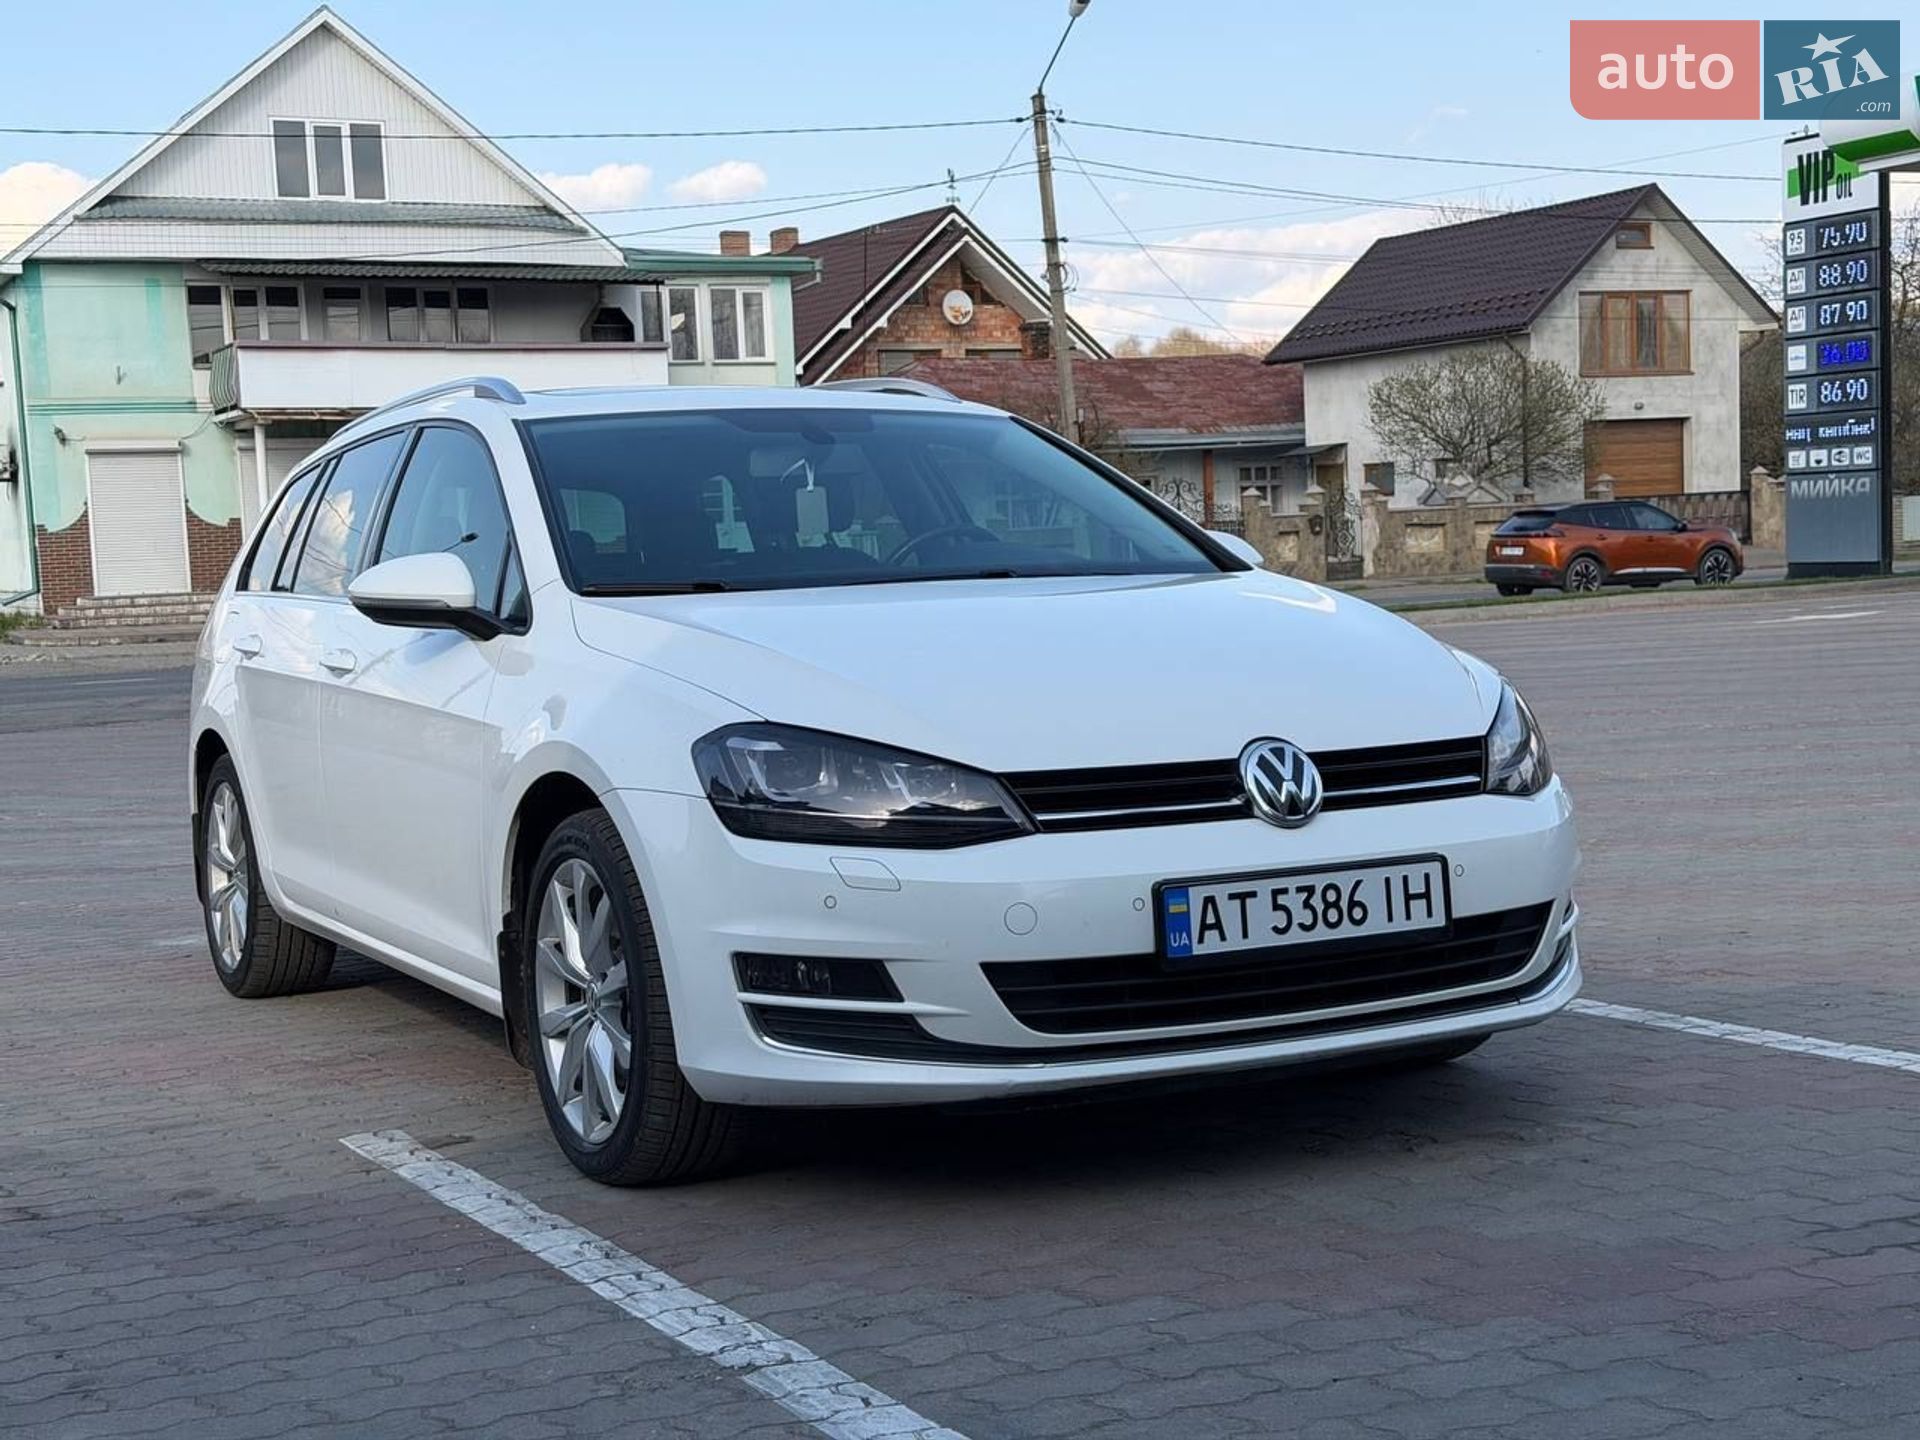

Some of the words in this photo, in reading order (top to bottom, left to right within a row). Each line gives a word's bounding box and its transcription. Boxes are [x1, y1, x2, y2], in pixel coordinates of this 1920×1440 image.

[1798, 149, 1835, 206] VIP
[1789, 231, 1803, 246] 95
[1819, 260, 1867, 287] 88.90
[1790, 389, 1805, 404] TIR
[1820, 378, 1868, 403] 86.90
[1856, 448, 1870, 459] WC
[1197, 890, 1258, 944] AT
[1270, 879, 1369, 935] 5386
[1384, 872, 1433, 923] IH
[1170, 928, 1190, 947] UA
